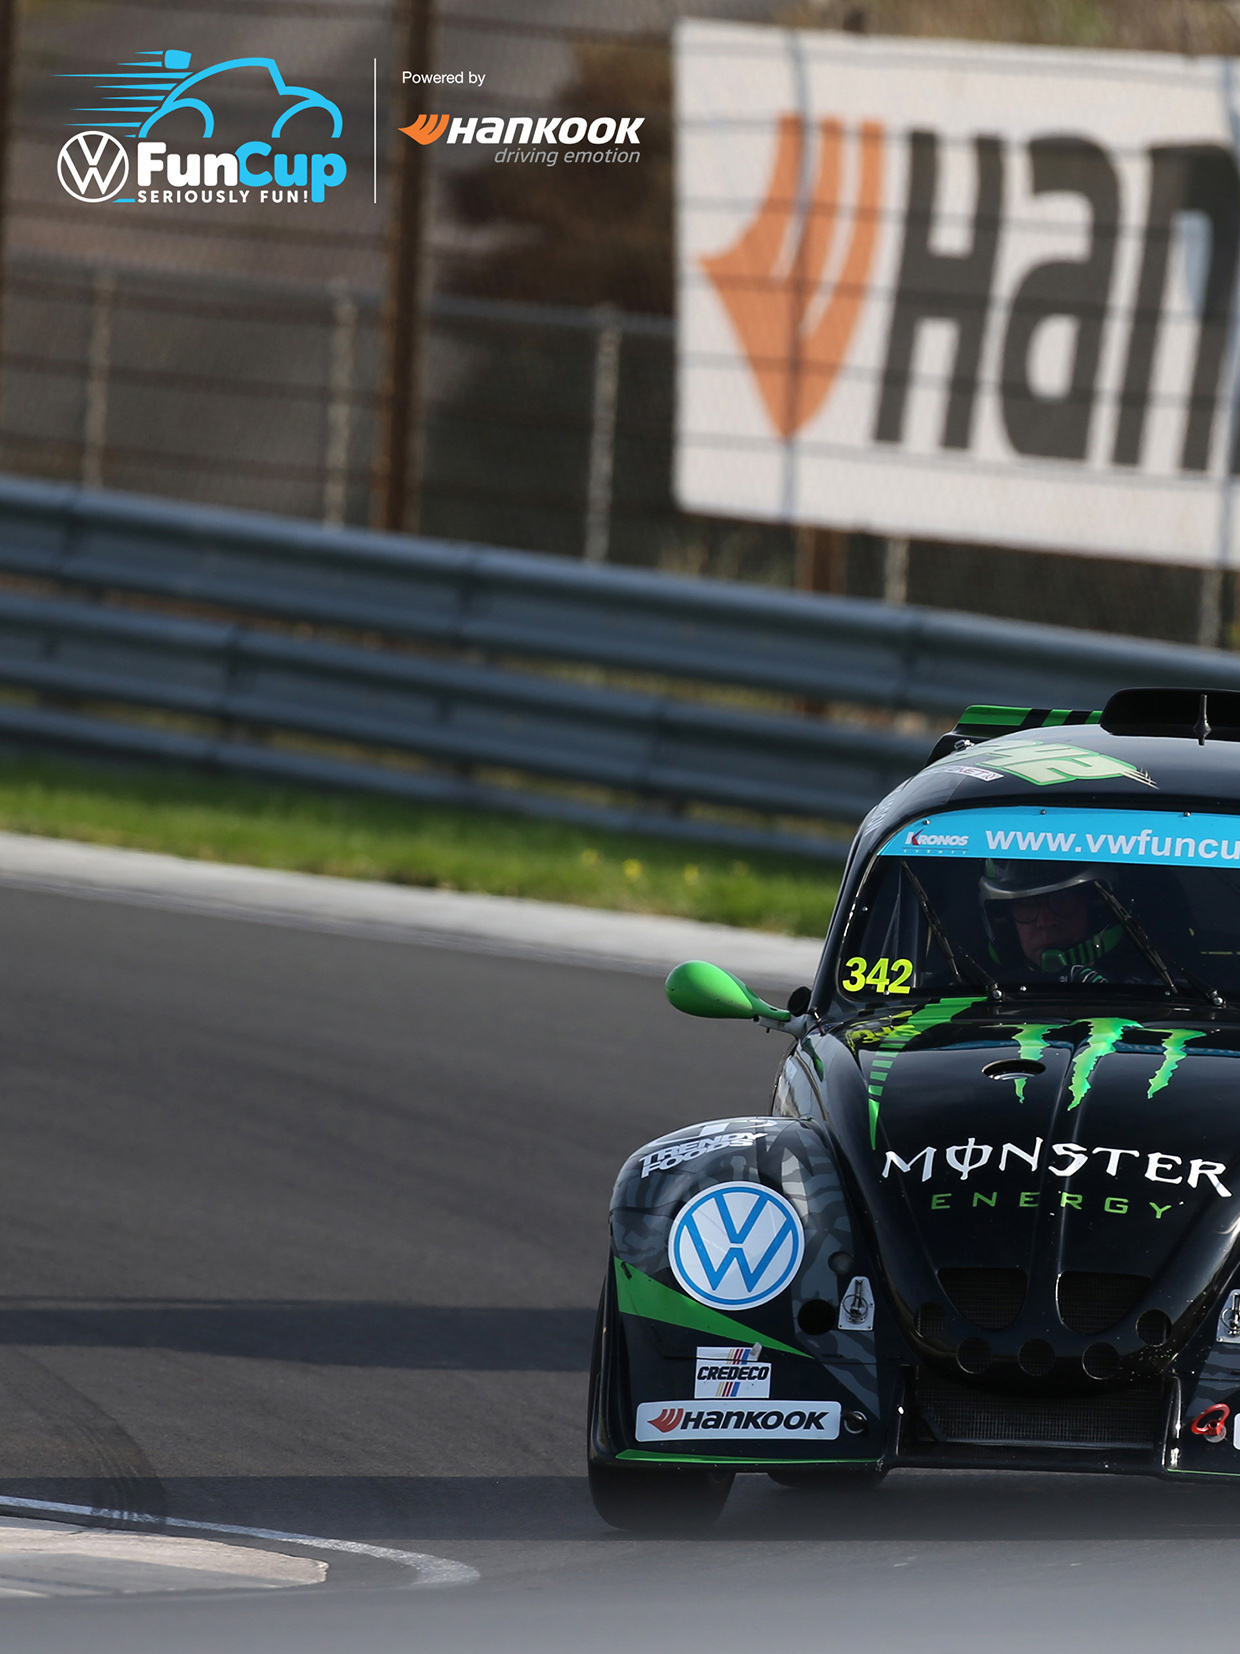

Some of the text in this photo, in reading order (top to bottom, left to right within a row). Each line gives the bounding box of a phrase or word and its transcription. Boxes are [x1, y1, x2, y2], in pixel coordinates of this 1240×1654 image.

[905, 829, 969, 846] KRONOS
[842, 957, 914, 994] 342
[639, 1133, 769, 1166] TRENDY
[641, 1140, 754, 1178] FOODS
[931, 1192, 1172, 1219] ENERGY
[697, 1366, 770, 1381] CREDECO
